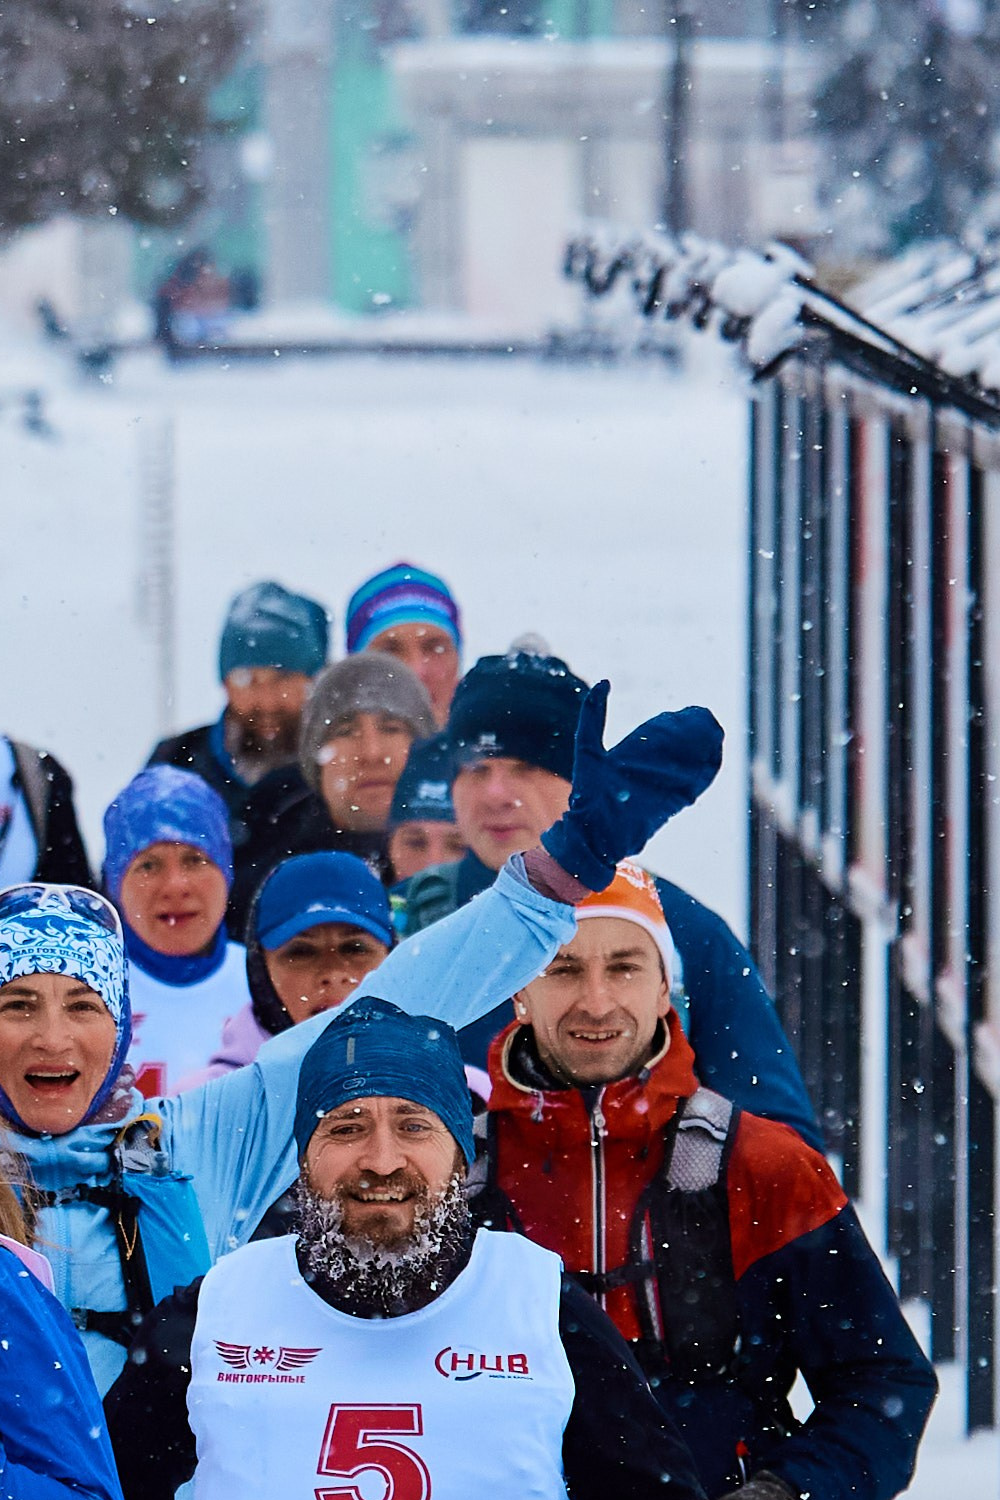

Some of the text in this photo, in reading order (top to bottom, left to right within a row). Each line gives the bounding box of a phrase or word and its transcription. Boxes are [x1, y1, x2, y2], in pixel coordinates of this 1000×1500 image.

[12, 948, 34, 957] MAD
[59, 950, 89, 964] ULTRA
[451, 1352, 529, 1374] НЦВ
[217, 1372, 306, 1384] ВИНТОКРЫЛЫЕ
